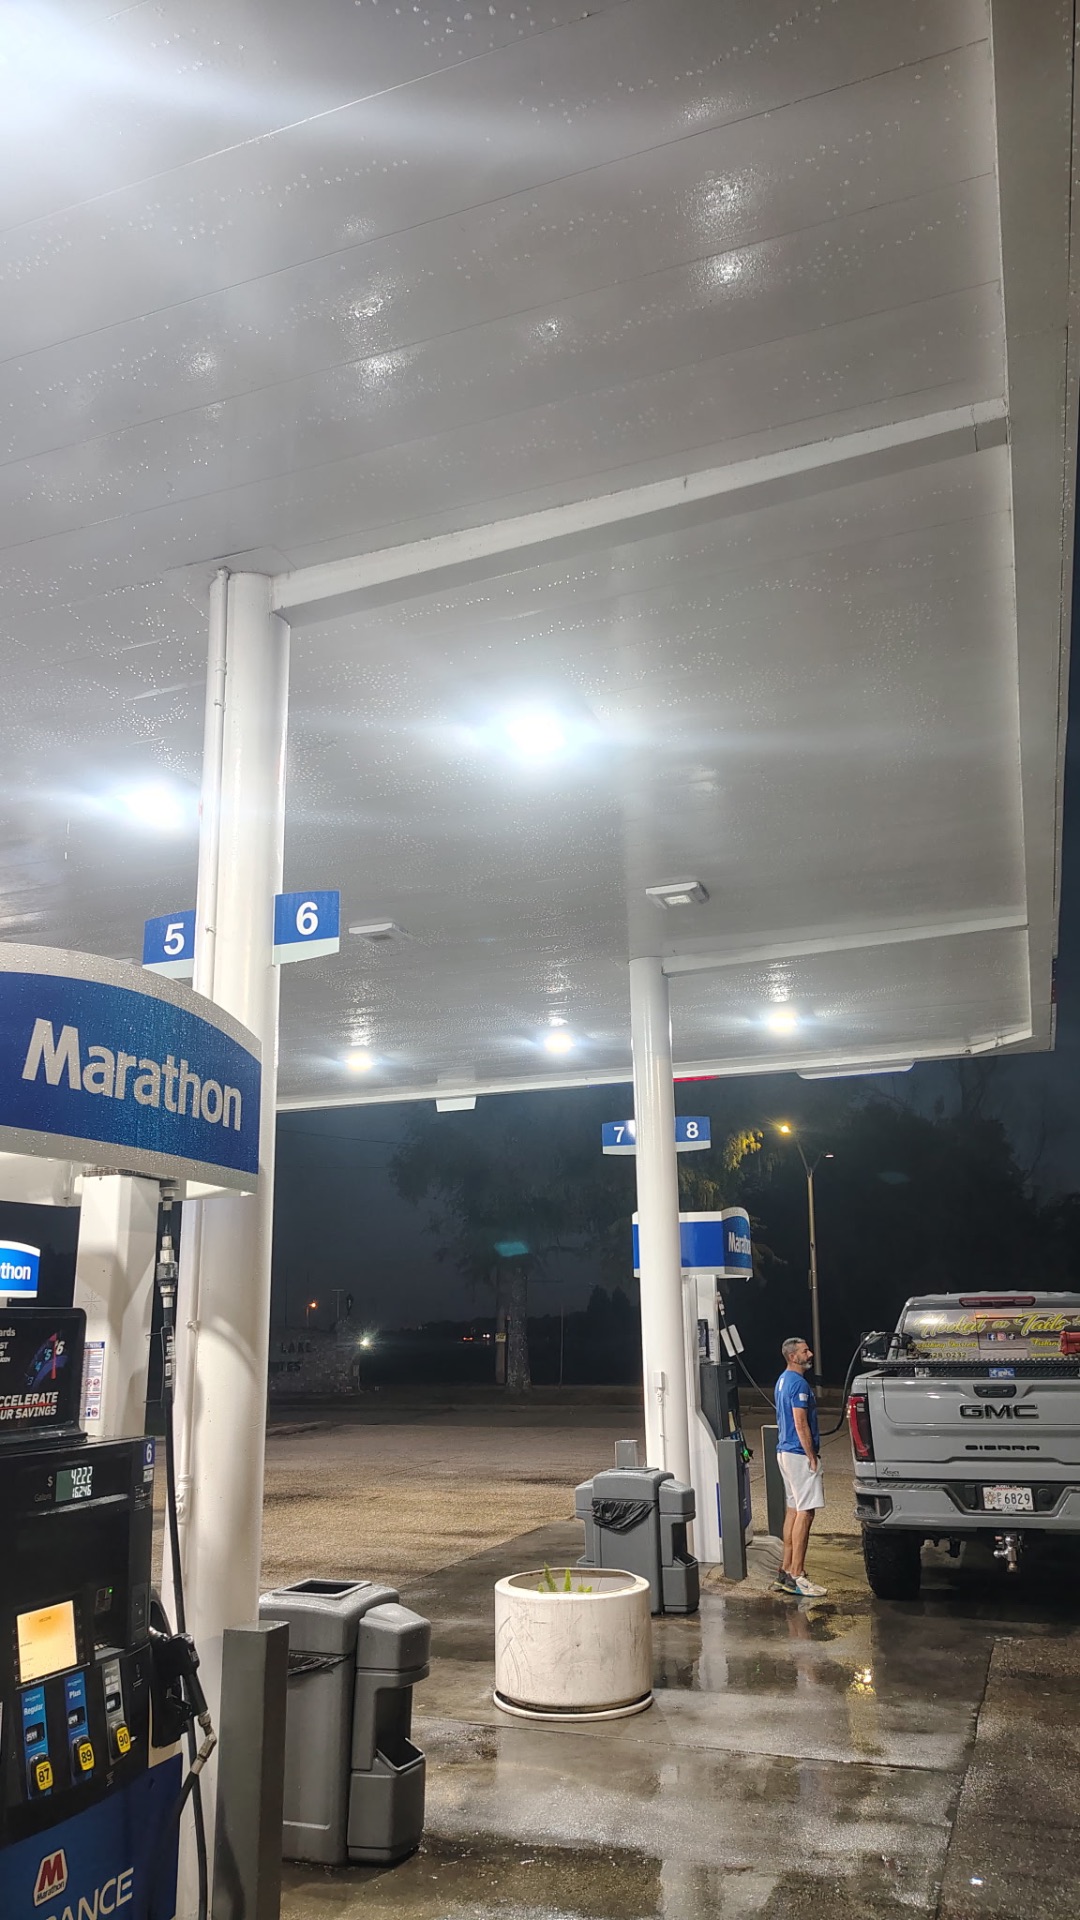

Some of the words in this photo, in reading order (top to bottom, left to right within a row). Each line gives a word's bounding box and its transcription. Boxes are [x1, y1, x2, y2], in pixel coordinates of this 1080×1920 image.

[295, 901, 319, 936] 6
[163, 922, 185, 955] 5
[22, 1017, 242, 1131] Marathon
[613, 1126, 625, 1143] 7
[686, 1121, 699, 1139] 8
[913, 1313, 989, 1337] Hooked
[1013, 1311, 1070, 1336] Tails
[15, 1405, 57, 1419] SAVINGS
[960, 1403, 1039, 1419] GMC
[146, 1443, 153, 1463] 6
[1004, 1492, 1030, 1504] 6829
[69, 1689, 81, 1699] Plus
[23, 1703, 43, 1716] Regular
[118, 1733, 129, 1746] 90
[81, 1750, 92, 1763] 89
[38, 1768, 50, 1783] 87
[36, 1881, 65, 1902] Marathon
